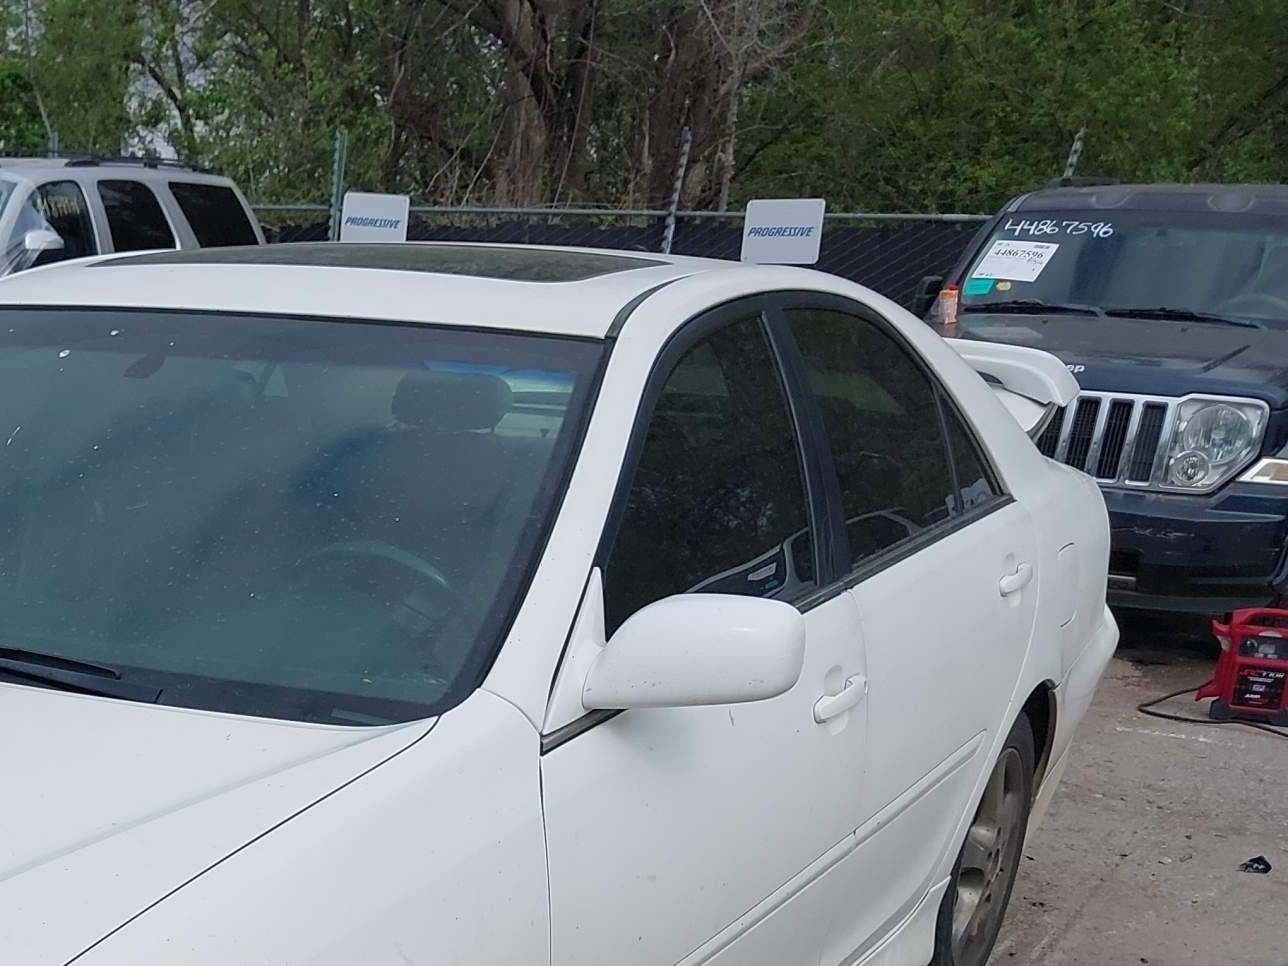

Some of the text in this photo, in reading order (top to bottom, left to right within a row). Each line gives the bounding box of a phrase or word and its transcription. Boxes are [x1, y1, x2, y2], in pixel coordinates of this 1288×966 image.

[344, 216, 401, 229] PROGRESSIVE
[747, 226, 815, 237] PROGRESSIVE
[994, 248, 1044, 259] 44867596
